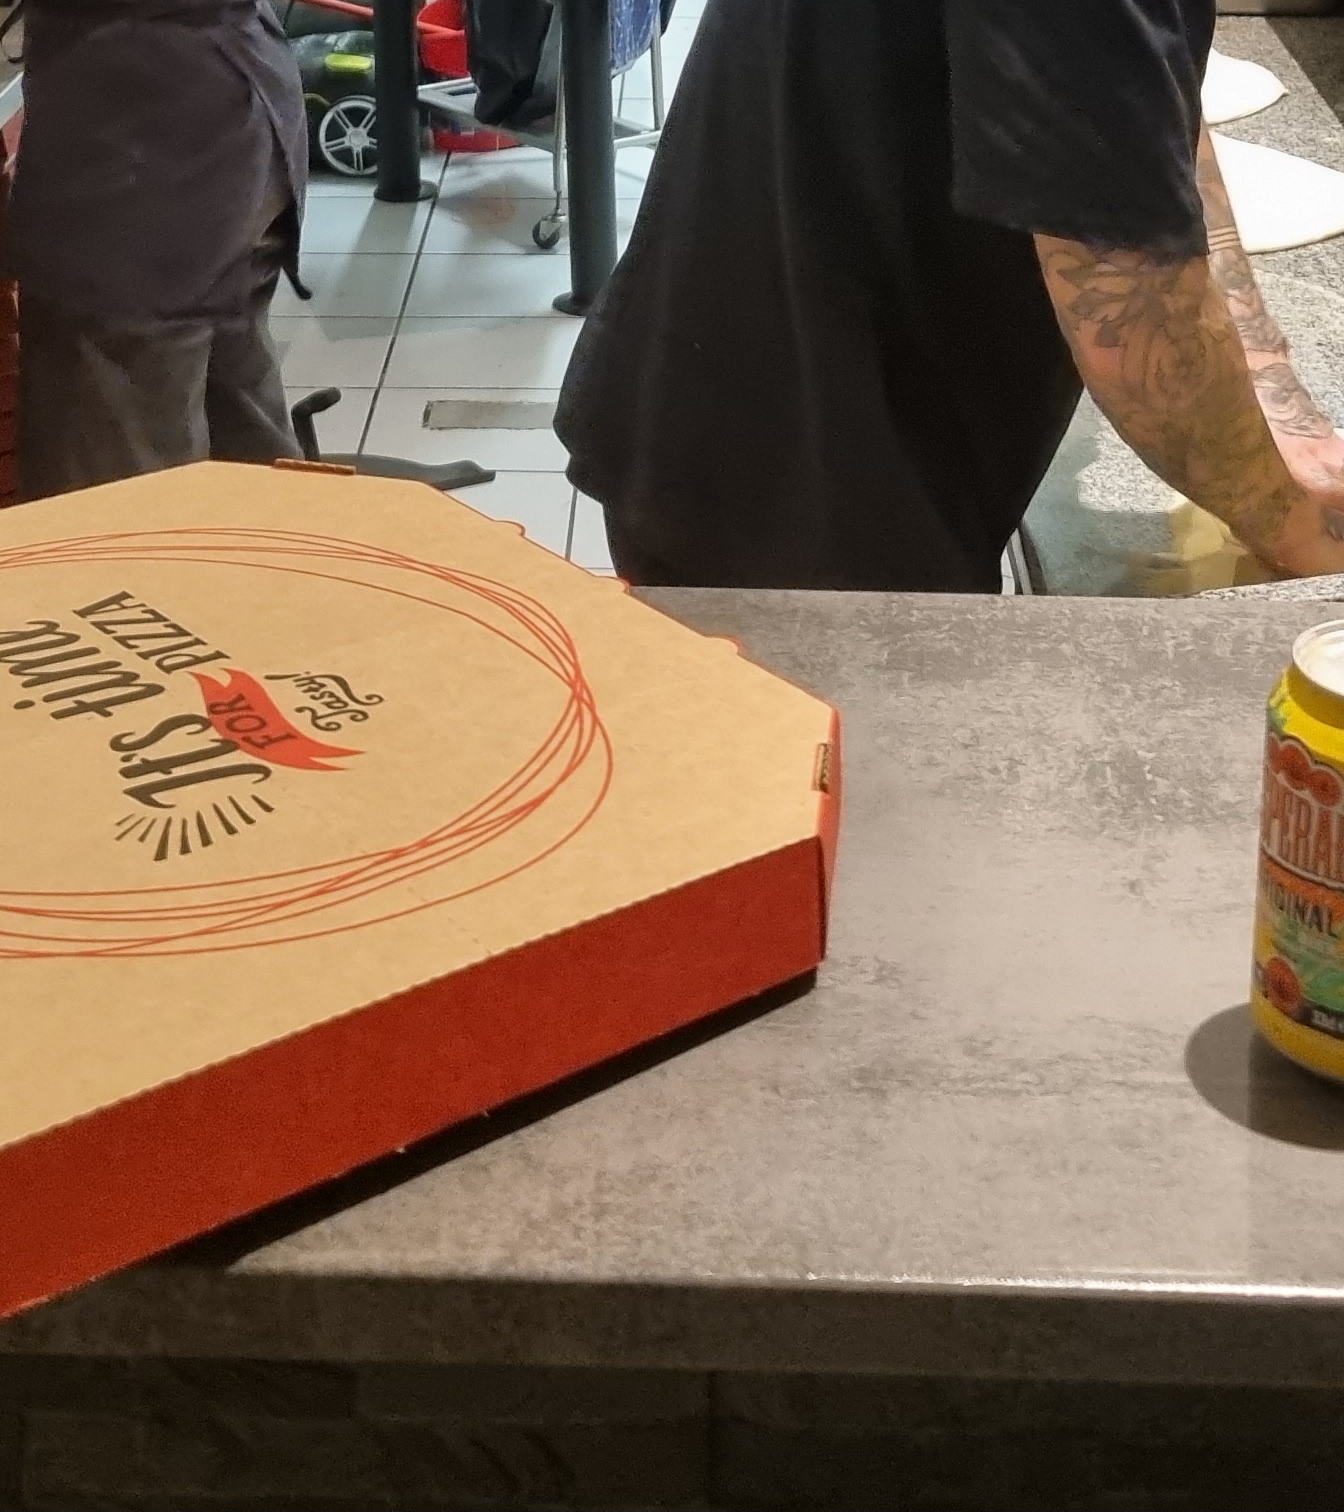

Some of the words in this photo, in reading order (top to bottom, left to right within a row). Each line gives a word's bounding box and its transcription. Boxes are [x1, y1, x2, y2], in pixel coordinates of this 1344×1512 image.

[72, 590, 231, 675] PIZZA
[208, 691, 297, 751] FOR
[262, 670, 384, 733] Tasty!
[108, 712, 271, 810] It's
